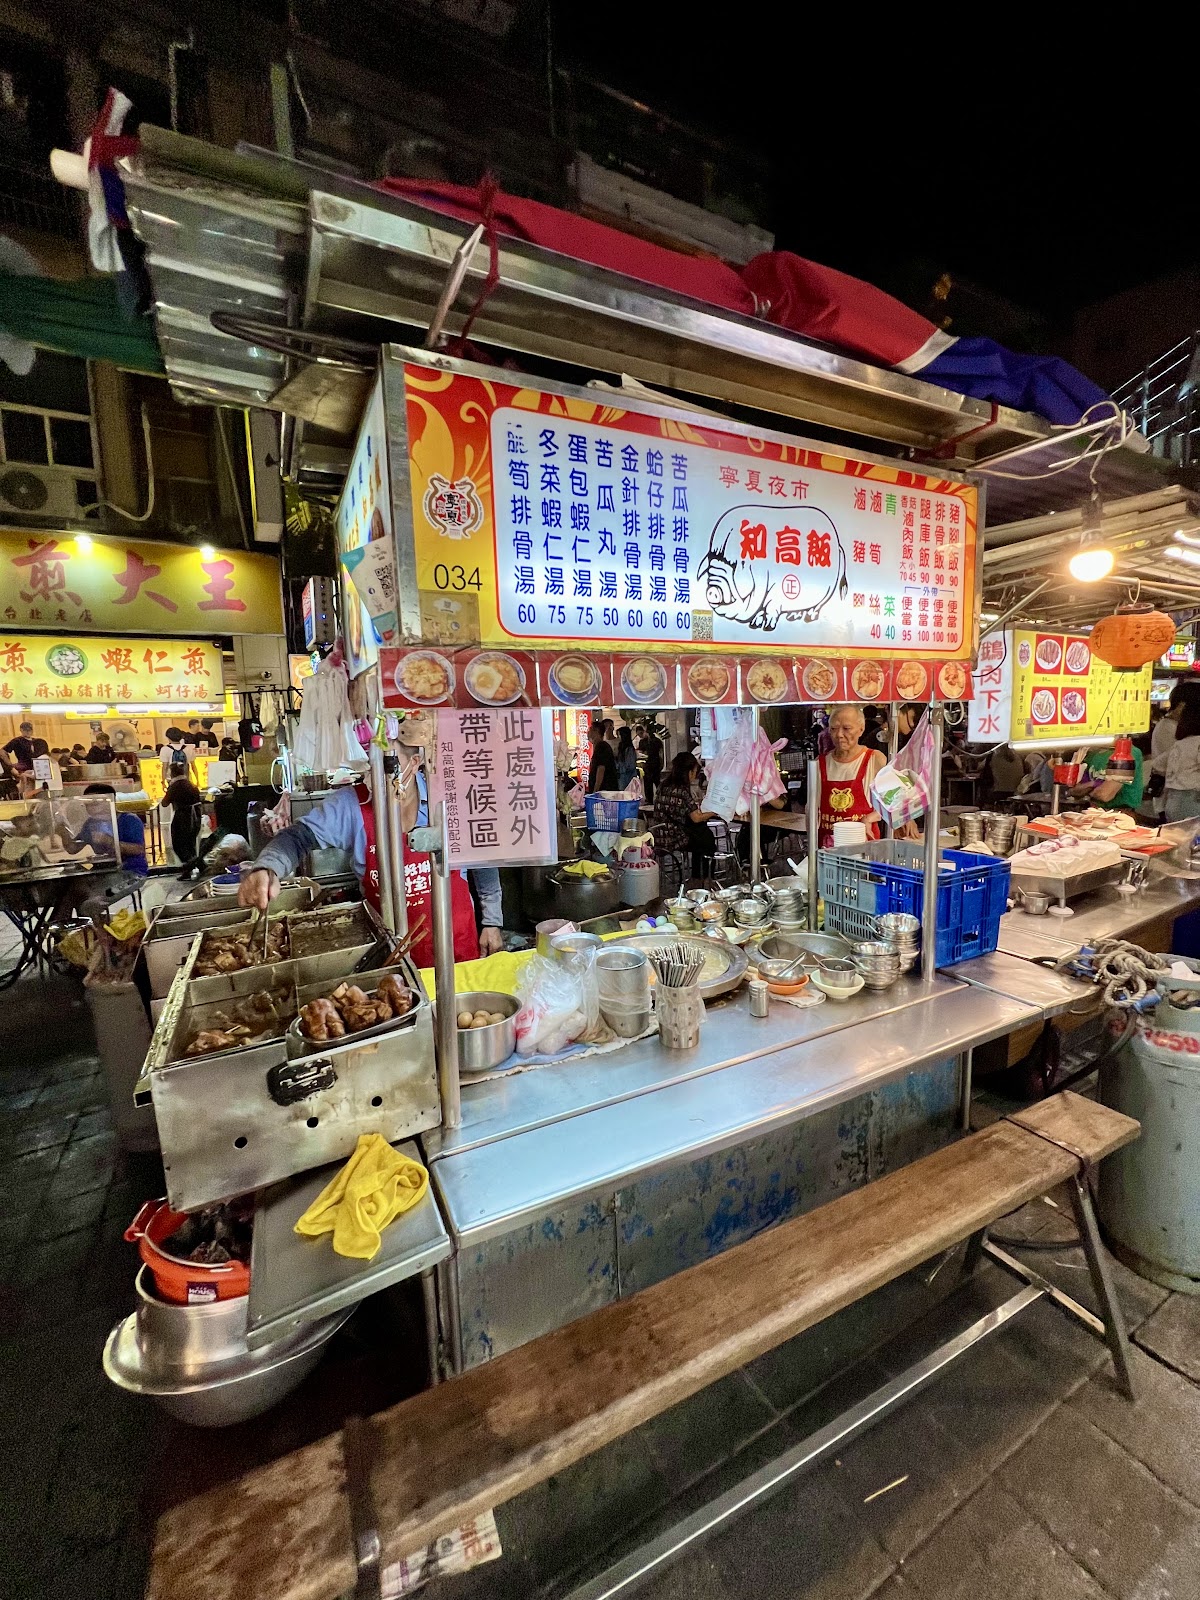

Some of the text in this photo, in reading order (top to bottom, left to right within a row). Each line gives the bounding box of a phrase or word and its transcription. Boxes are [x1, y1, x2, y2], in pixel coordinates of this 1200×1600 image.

[719, 465, 809, 500] 寧夏夜市
[901, 495, 917, 510] 香菇
[538, 429, 566, 624] 冬菜蝦仁湯 75
[567, 433, 594, 625] 蛋包蝦仁湯 75
[594, 438, 619, 626] 苦瓜丸湯 50
[620, 444, 643, 627] 金針排骨湯 60
[646, 448, 667, 629] 蛤仔排骨湯 60
[671, 453, 691, 630] 苦瓜排骨湯 60
[739, 519, 832, 568] 知高飯
[934, 501, 946, 585] 排骨飯 90
[12, 539, 247, 613] 煎大王
[434, 563, 483, 591] 034
[786, 580, 797, 595] 正
[884, 493, 897, 640] 青菜 40
[899, 561, 915, 570] 大 小
[899, 571, 917, 582] 70 45
[920, 571, 930, 584] 90
[949, 575, 959, 587] 90
[518, 604, 536, 624] 60
[922, 586, 939, 597] 外帶
[870, 624, 881, 640] 40
[901, 596, 913, 641] 便當 95
[917, 597, 930, 642] 便當 100
[932, 599, 944, 643] 便當 100
[946, 600, 958, 643] 便當 100
[101, 647, 211, 677] 蝦仁煎
[977, 641, 1004, 735] 鵝肉下水
[440, 741, 462, 854] 知高飯感謝您的配合
[458, 713, 501, 848] 帶等候區
[503, 711, 541, 846] 此處為外
